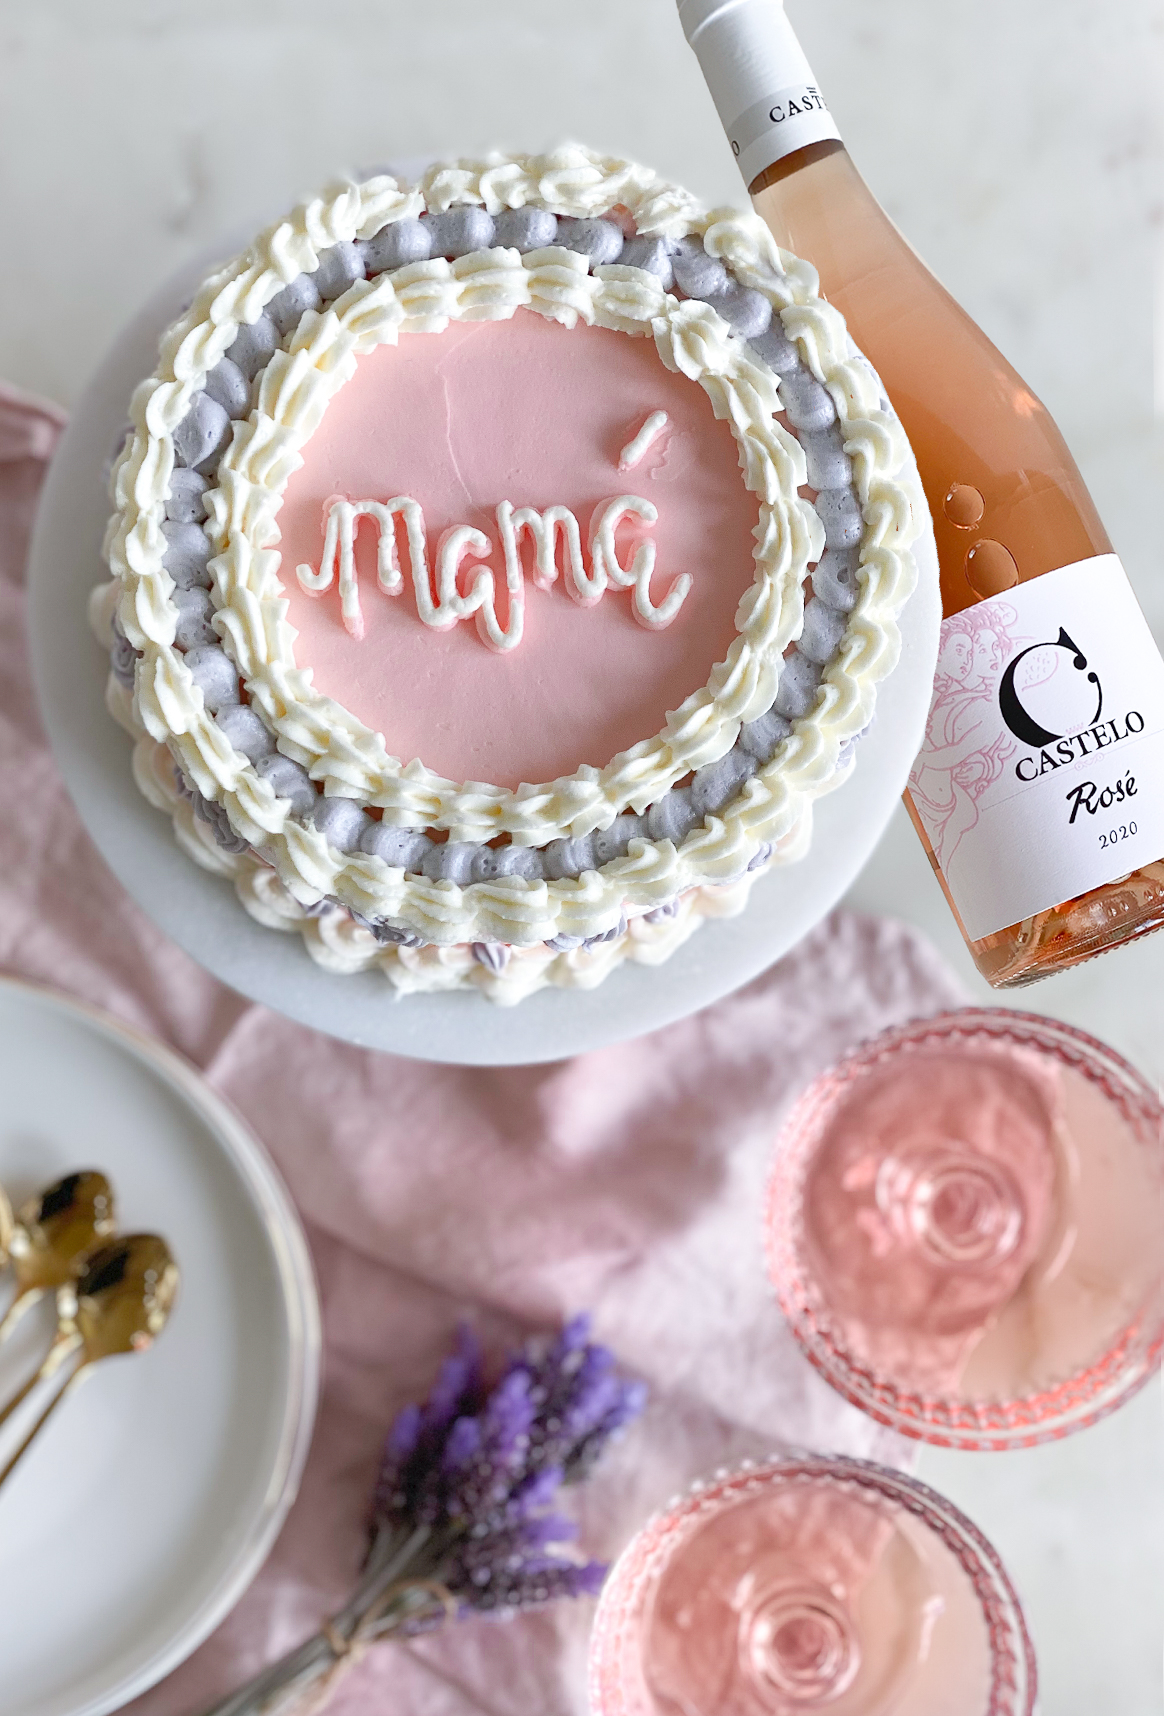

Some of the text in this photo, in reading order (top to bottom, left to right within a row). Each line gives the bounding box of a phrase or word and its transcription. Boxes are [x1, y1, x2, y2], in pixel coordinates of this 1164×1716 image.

[769, 95, 826, 123] CAST
[999, 626, 1103, 749] C
[1015, 711, 1145, 782] CASTELO
[1065, 769, 1138, 824] Rosé
[1098, 821, 1138, 850] 2020
